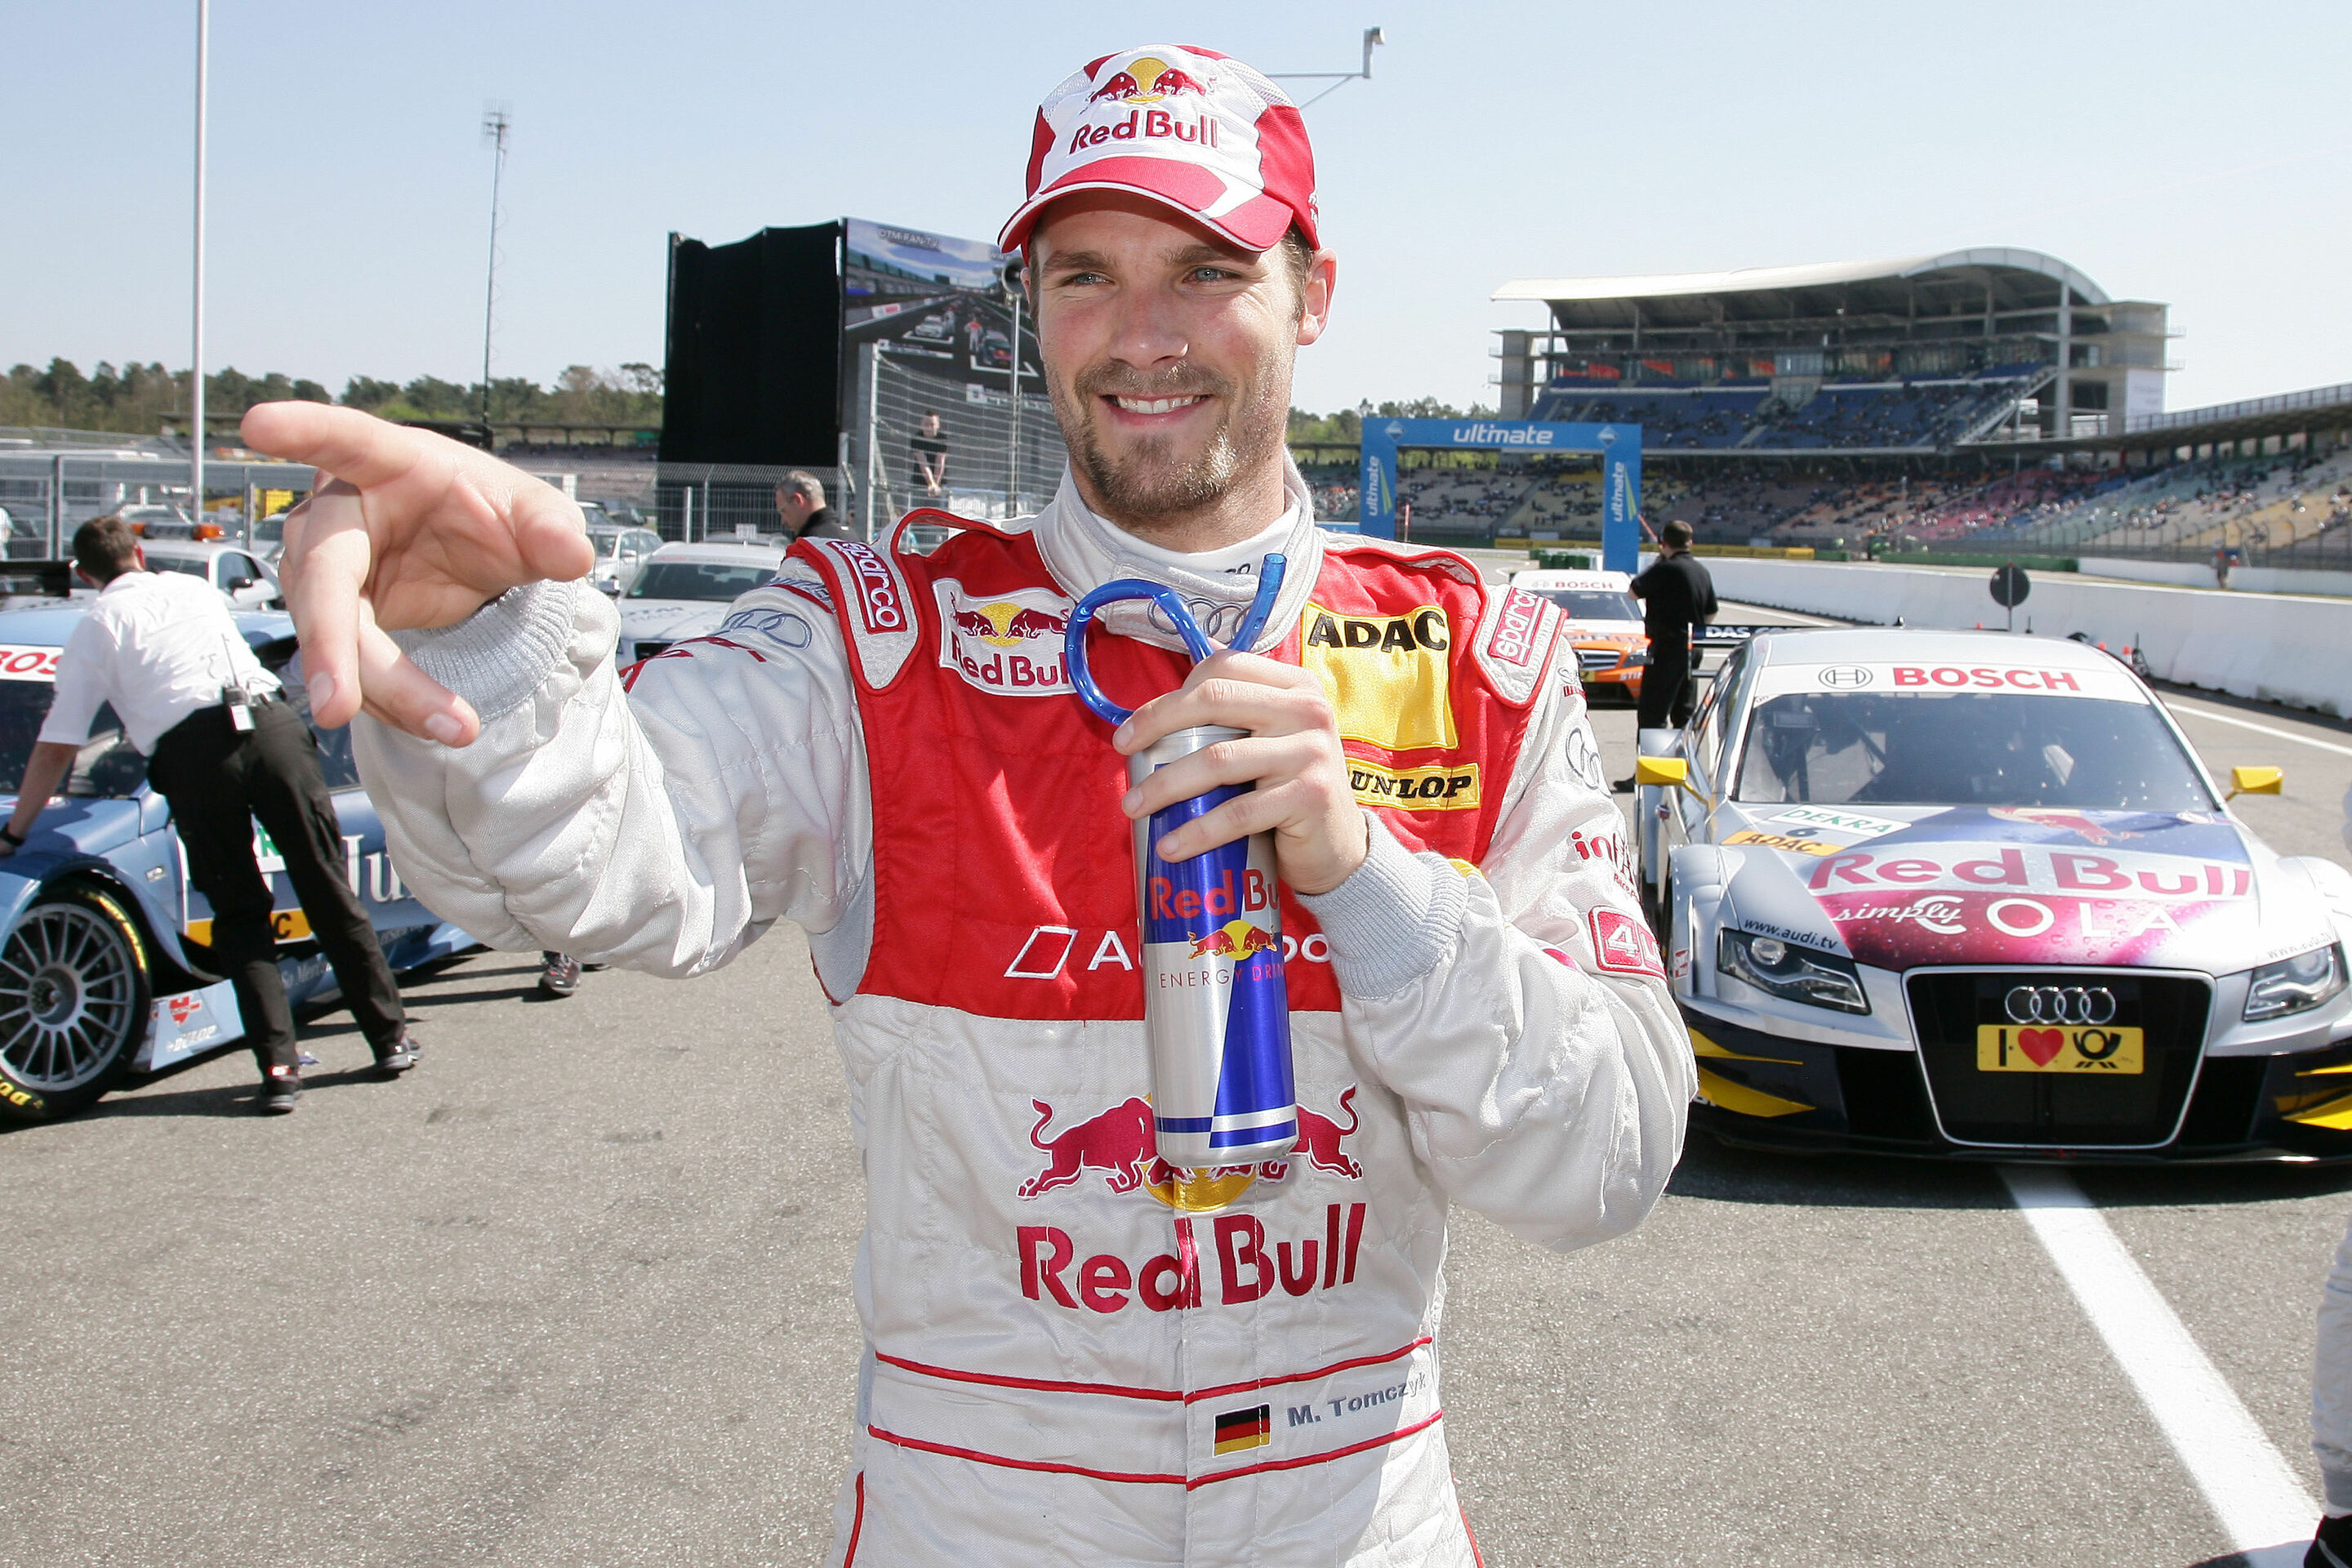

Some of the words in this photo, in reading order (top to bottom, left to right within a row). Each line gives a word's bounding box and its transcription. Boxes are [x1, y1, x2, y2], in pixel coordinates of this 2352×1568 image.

[1069, 109, 1138, 154] Red
[1146, 109, 1219, 148] Bull
[1453, 424, 1553, 445] ultimate
[1365, 455, 1380, 517] ultimate
[1609, 461, 1625, 523] ultimate
[833, 541, 901, 628] sparco
[1554, 581, 1614, 589] BOSCH
[1307, 610, 1448, 653] ADAC
[1705, 626, 1751, 638] DAS
[951, 630, 1004, 686] Red
[1009, 652, 1070, 687] Bul
[1893, 666, 2081, 692] BOSCH
[1348, 769, 1472, 799] UNLOP
[1743, 833, 1824, 853] ADAC
[1782, 809, 1893, 835] DEKRA
[1807, 848, 2029, 890] Red
[2050, 852, 2252, 896] Bull
[1148, 869, 1236, 920] Red
[1830, 902, 1962, 924] simply
[1914, 894, 2186, 938] COLA
[1744, 919, 1838, 950] www.audi.tv
[1160, 968, 1242, 989] ENERGY
[1016, 1218, 1202, 1313] Red
[1213, 1202, 1366, 1305] Bull
[1287, 1405, 1321, 1428] M.
[1327, 1371, 1427, 1418] Tomczyk
